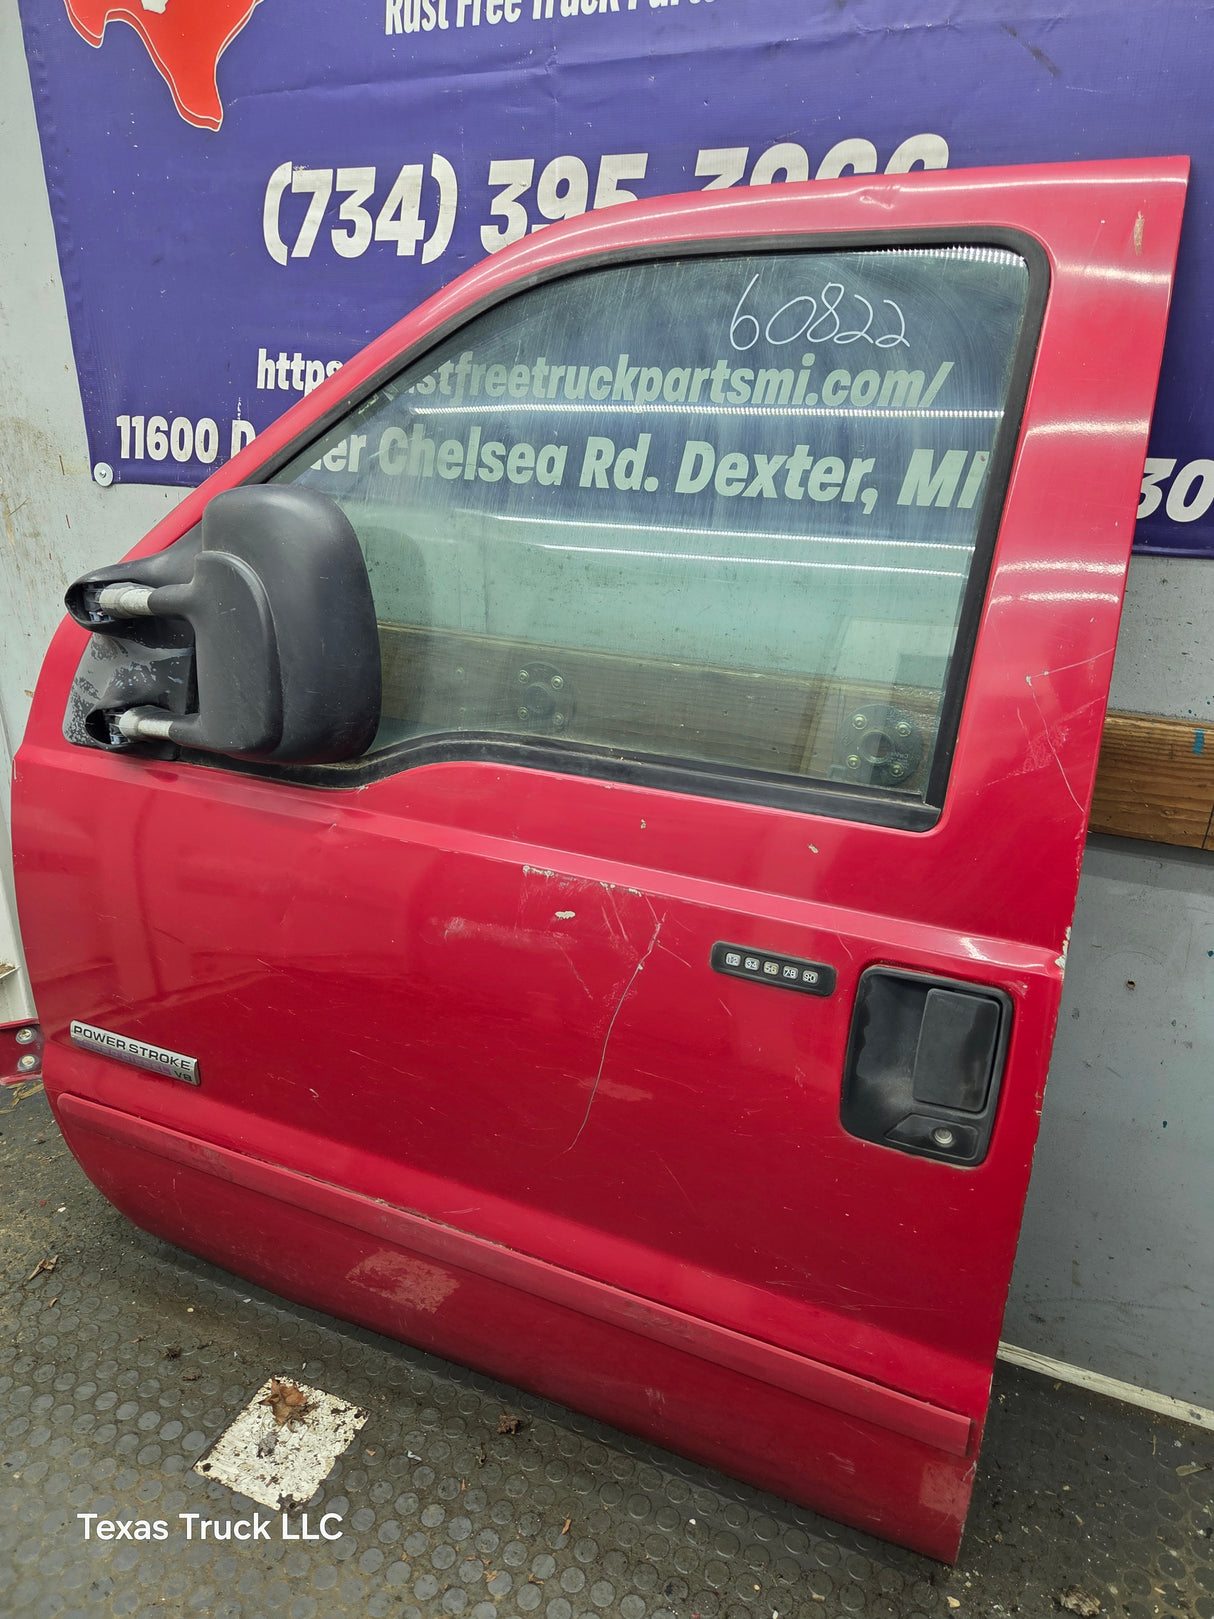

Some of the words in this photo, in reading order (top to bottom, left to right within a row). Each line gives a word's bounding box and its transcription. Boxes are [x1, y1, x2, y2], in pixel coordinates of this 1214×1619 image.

[263, 153, 458, 266] (734)
[730, 274, 910, 350] 60822
[116, 415, 219, 464] 11600
[379, 424, 569, 487] Chelsea
[579, 433, 659, 492] Rd.
[675, 440, 879, 514] Dexter,
[897, 449, 990, 508] MI
[73, 1025, 126, 1050] POWER
[128, 1043, 191, 1071] STROKE
[174, 1070, 192, 1083] V8
